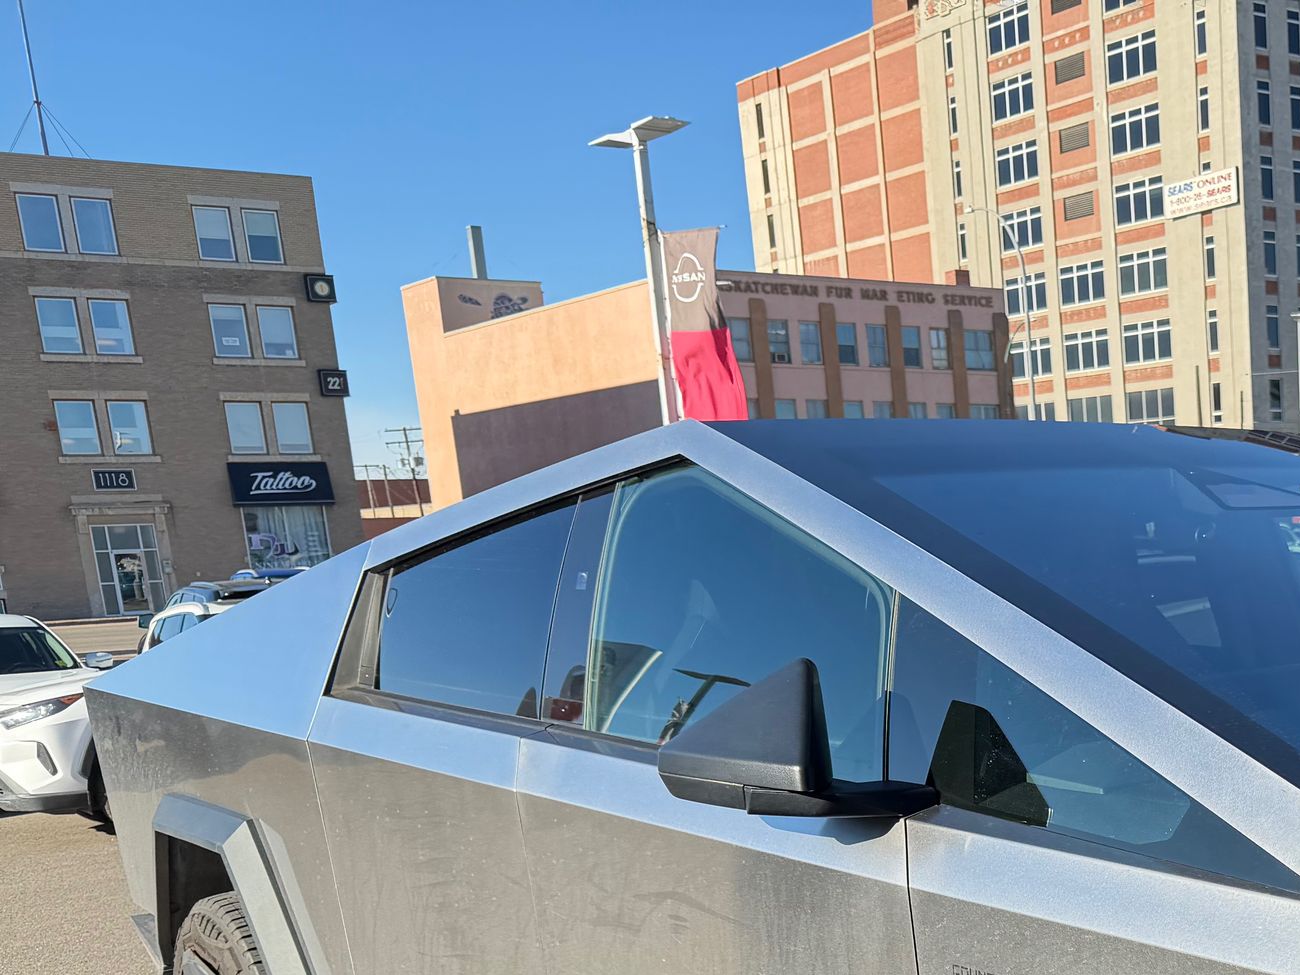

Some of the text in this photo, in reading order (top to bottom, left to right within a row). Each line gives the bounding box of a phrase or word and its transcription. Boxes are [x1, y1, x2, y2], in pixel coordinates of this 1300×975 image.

[1168, 173, 1232, 197] SEARS ONLINE
[826, 285, 853, 299] FUR
[943, 293, 994, 308] SERVICE
[99, 473, 129, 487] 1118
[250, 471, 317, 495] Tattoo
